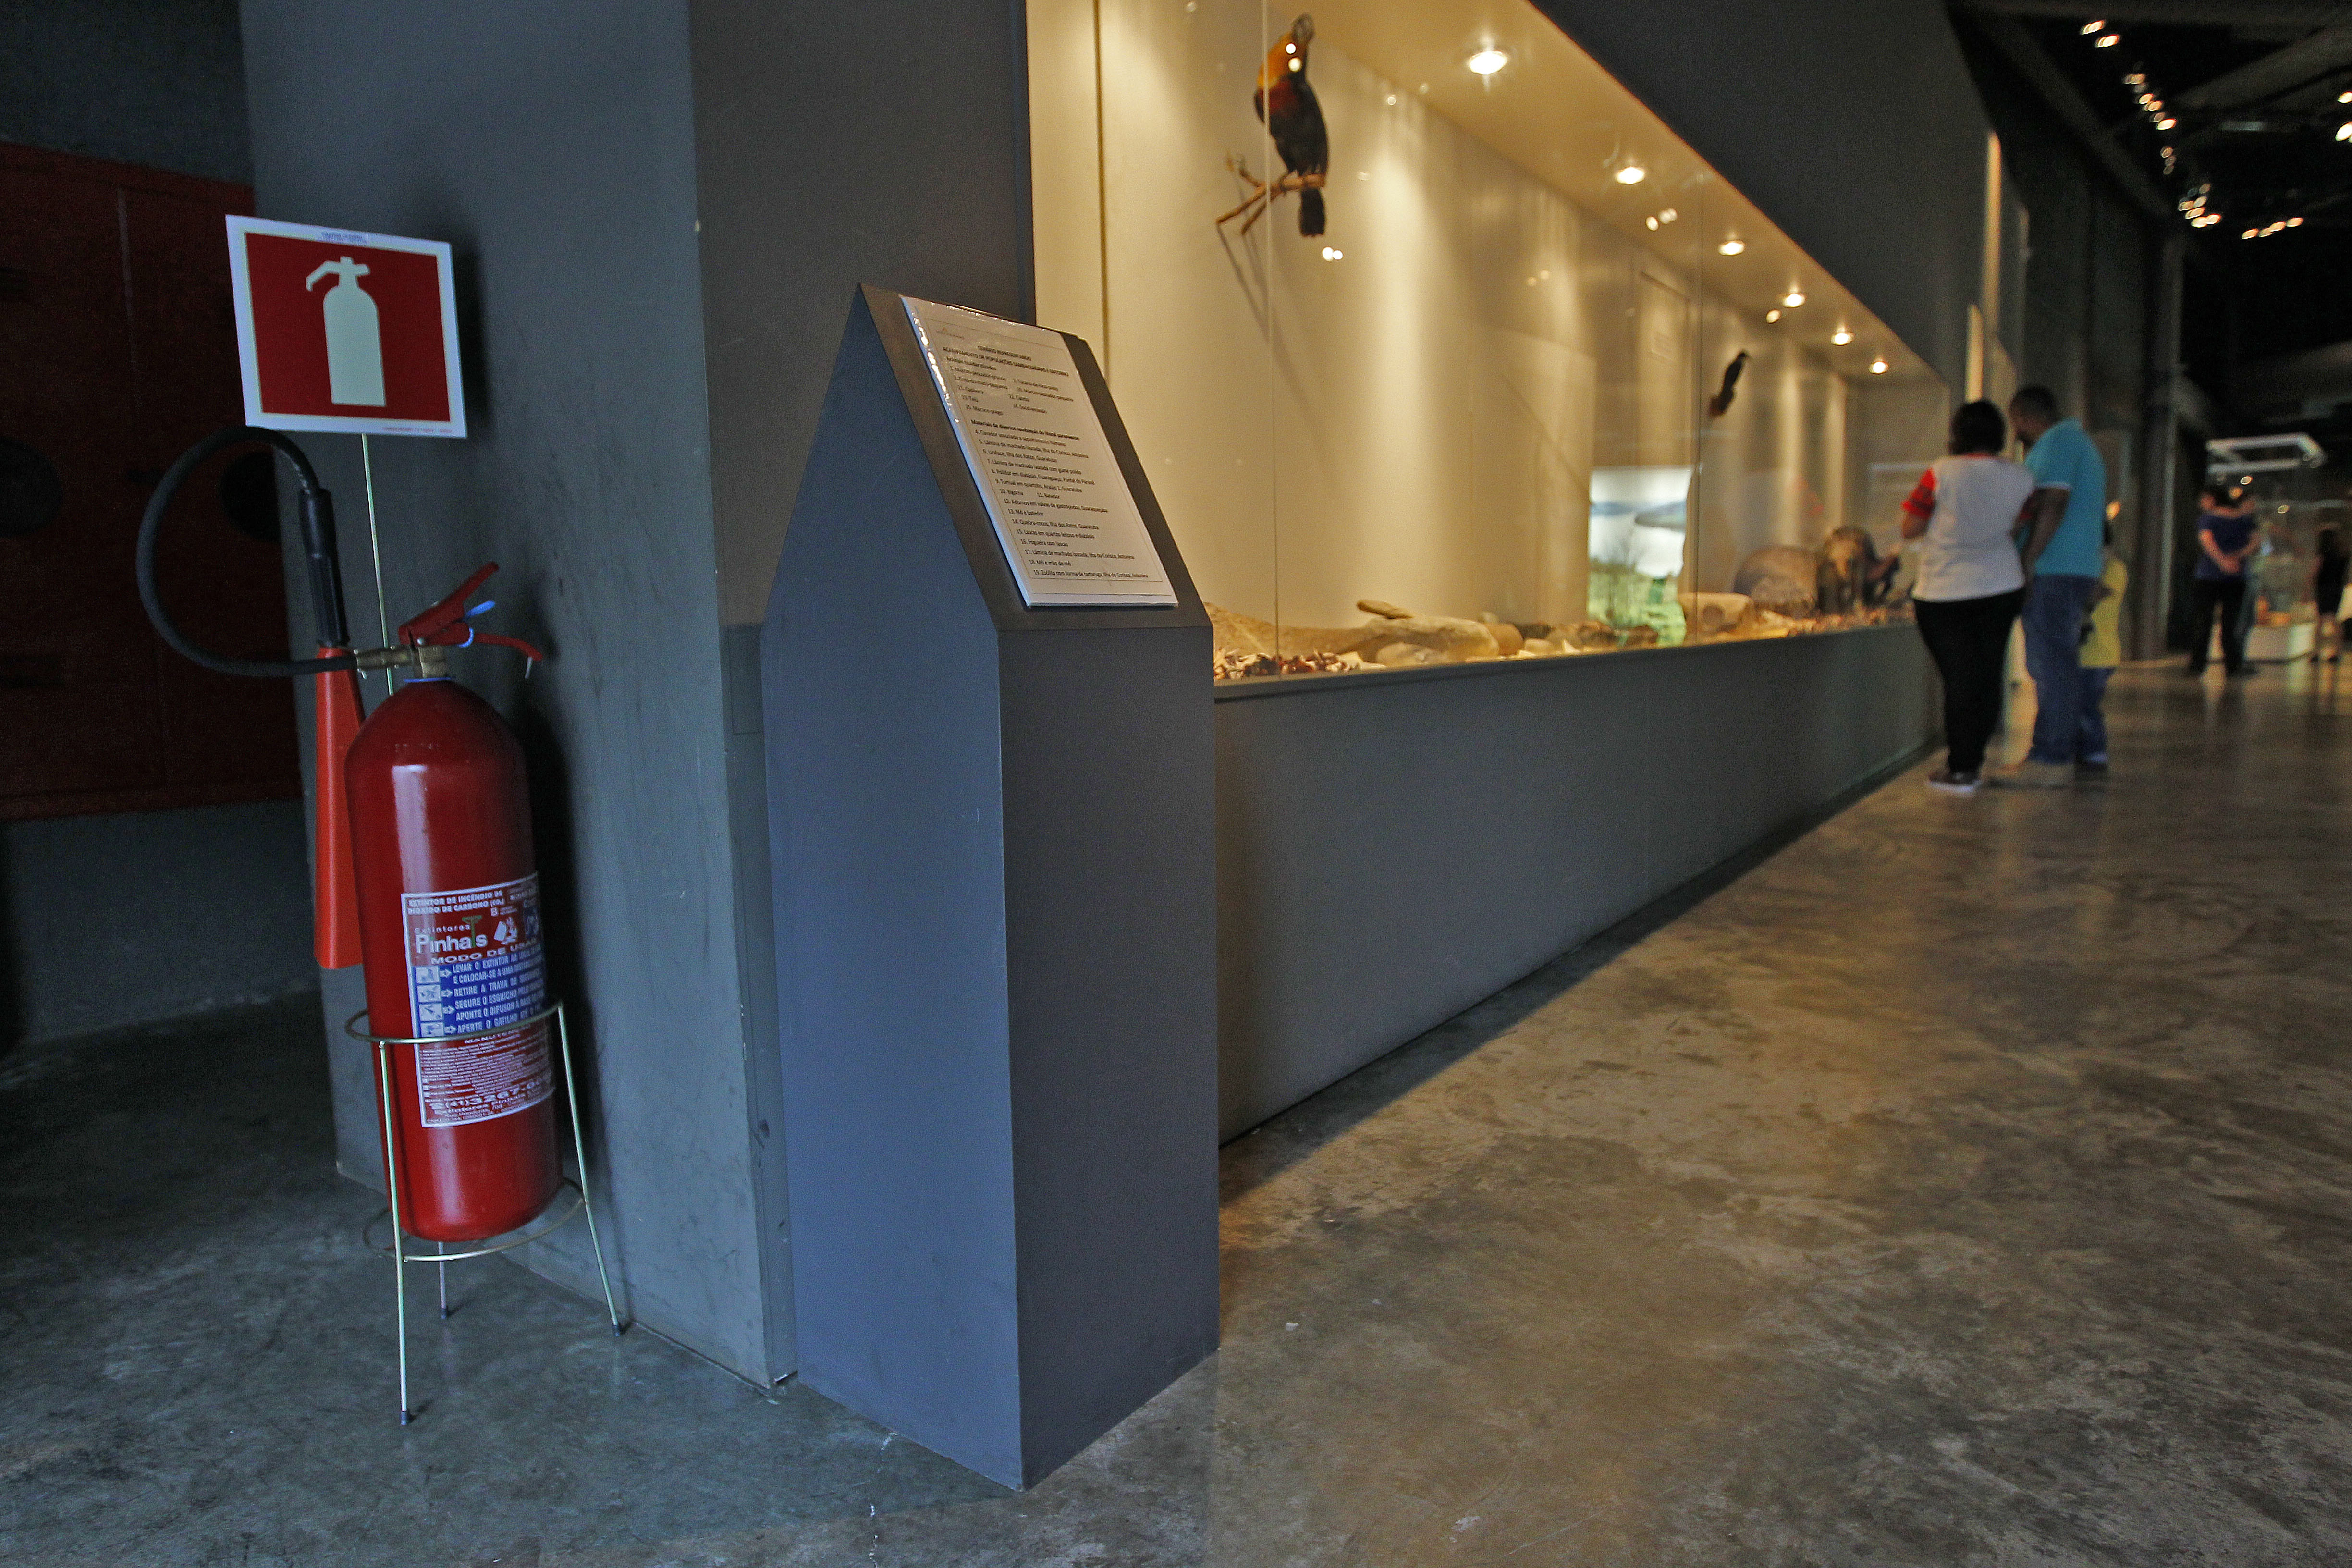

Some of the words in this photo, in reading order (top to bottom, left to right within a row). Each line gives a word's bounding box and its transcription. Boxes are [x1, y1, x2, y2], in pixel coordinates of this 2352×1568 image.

[407, 906, 441, 914] DIÓXIDO
[453, 901, 488, 911] CARBONO
[408, 897, 445, 907] EXTINTOR
[458, 893, 492, 903] INCÊNDIO
[415, 924, 470, 934] Extintores
[431, 953, 482, 964] MODO
[487, 947, 506, 957] DE
[510, 939, 538, 950] USAR
[452, 964, 471, 973] LEVAR
[475, 962, 479, 970] O
[482, 956, 509, 968] EXTINTOR
[511, 954, 518, 962] AO
[453, 976, 459, 984] E
[459, 969, 496, 983] COLOCAR-SE
[502, 966, 514, 975] UMA
[454, 987, 477, 997] RETIRE
[481, 984, 486, 992] A
[489, 980, 508, 991] TRAVA
[455, 998, 481, 1009] SEGURE
[482, 997, 488, 1005] O
[489, 990, 517, 1003] ESGUICHO
[456, 1009, 482, 1021] APONTE
[483, 1007, 489, 1017] O
[490, 1001, 514, 1015] DIFUSOR
[457, 1021, 483, 1033] APERTE
[486, 1020, 490, 1029] O
[494, 1013, 517, 1027] GATILHO
